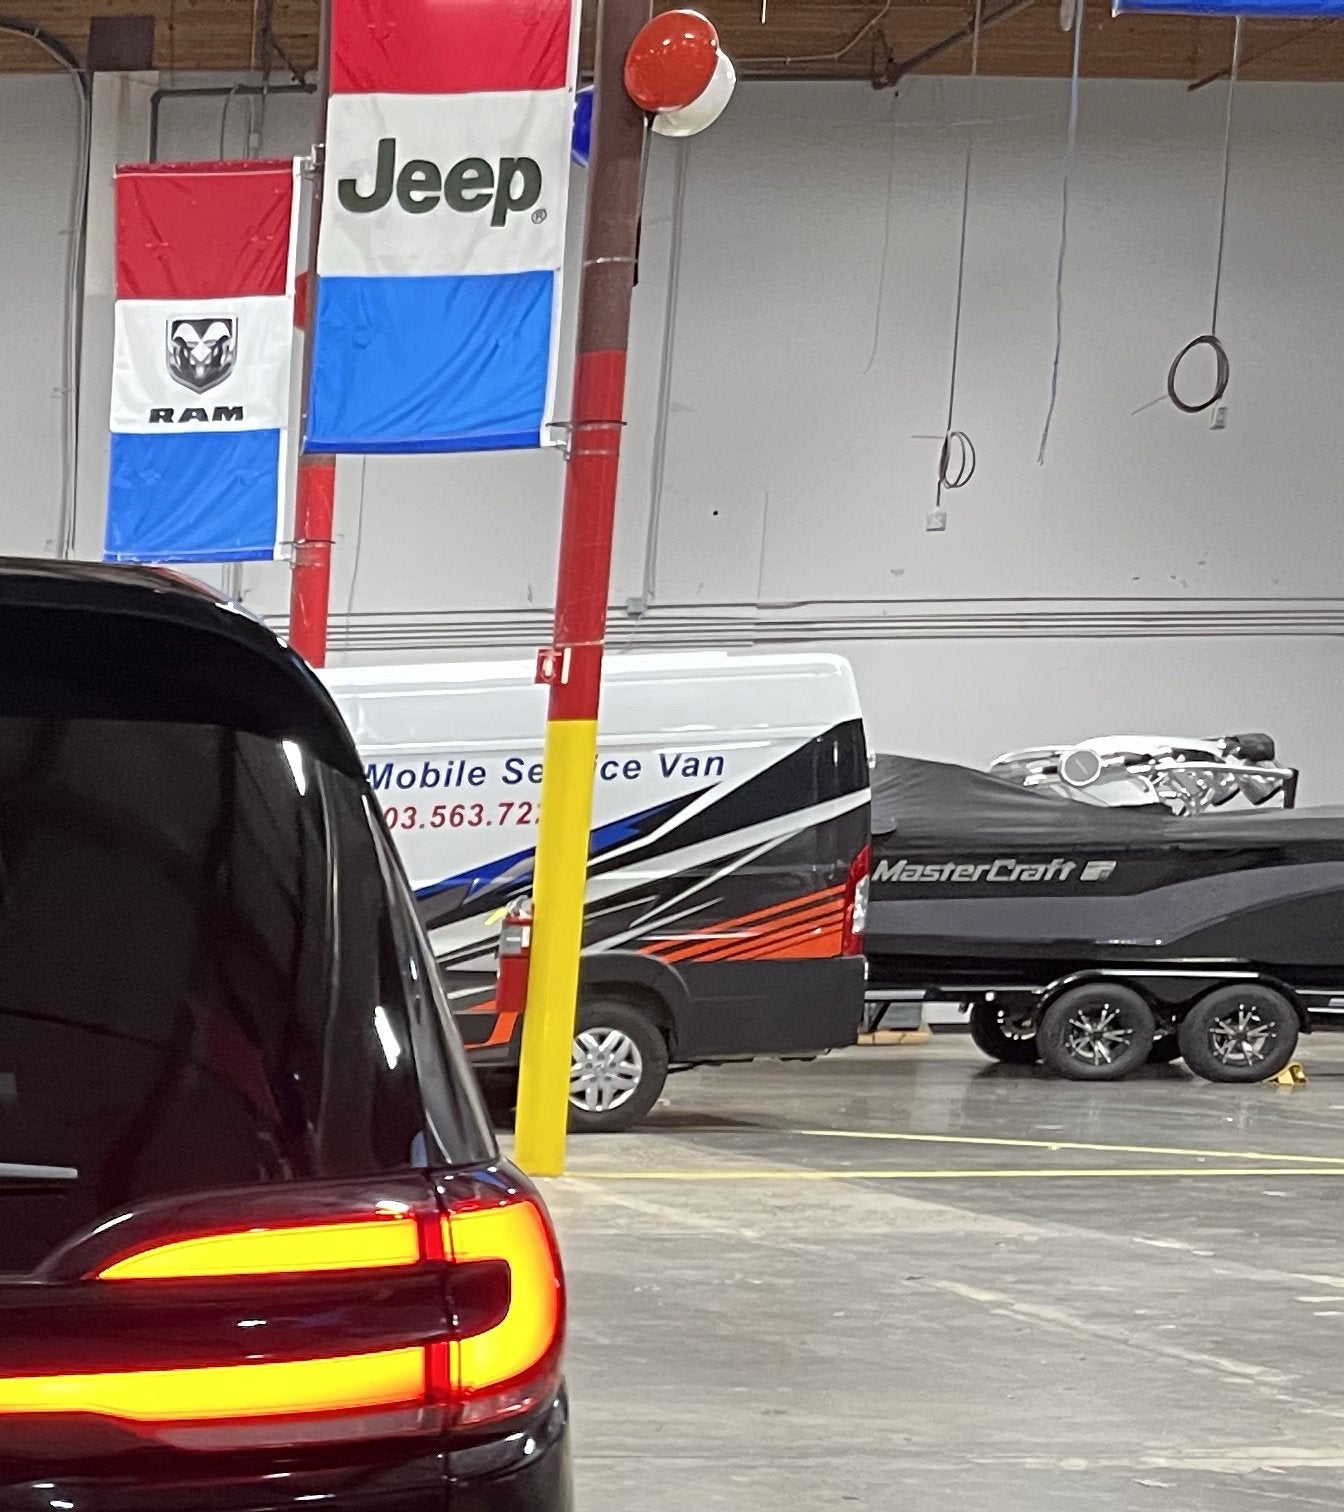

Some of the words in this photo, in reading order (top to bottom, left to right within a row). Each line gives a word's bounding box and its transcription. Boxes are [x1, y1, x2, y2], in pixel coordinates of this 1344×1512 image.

[337, 138, 543, 228] Jeep
[148, 405, 244, 424] RAM
[365, 760, 487, 790] Mobile
[501, 757, 641, 785] Sece
[659, 753, 725, 779] Van
[870, 858, 1077, 882] MasterCraft
